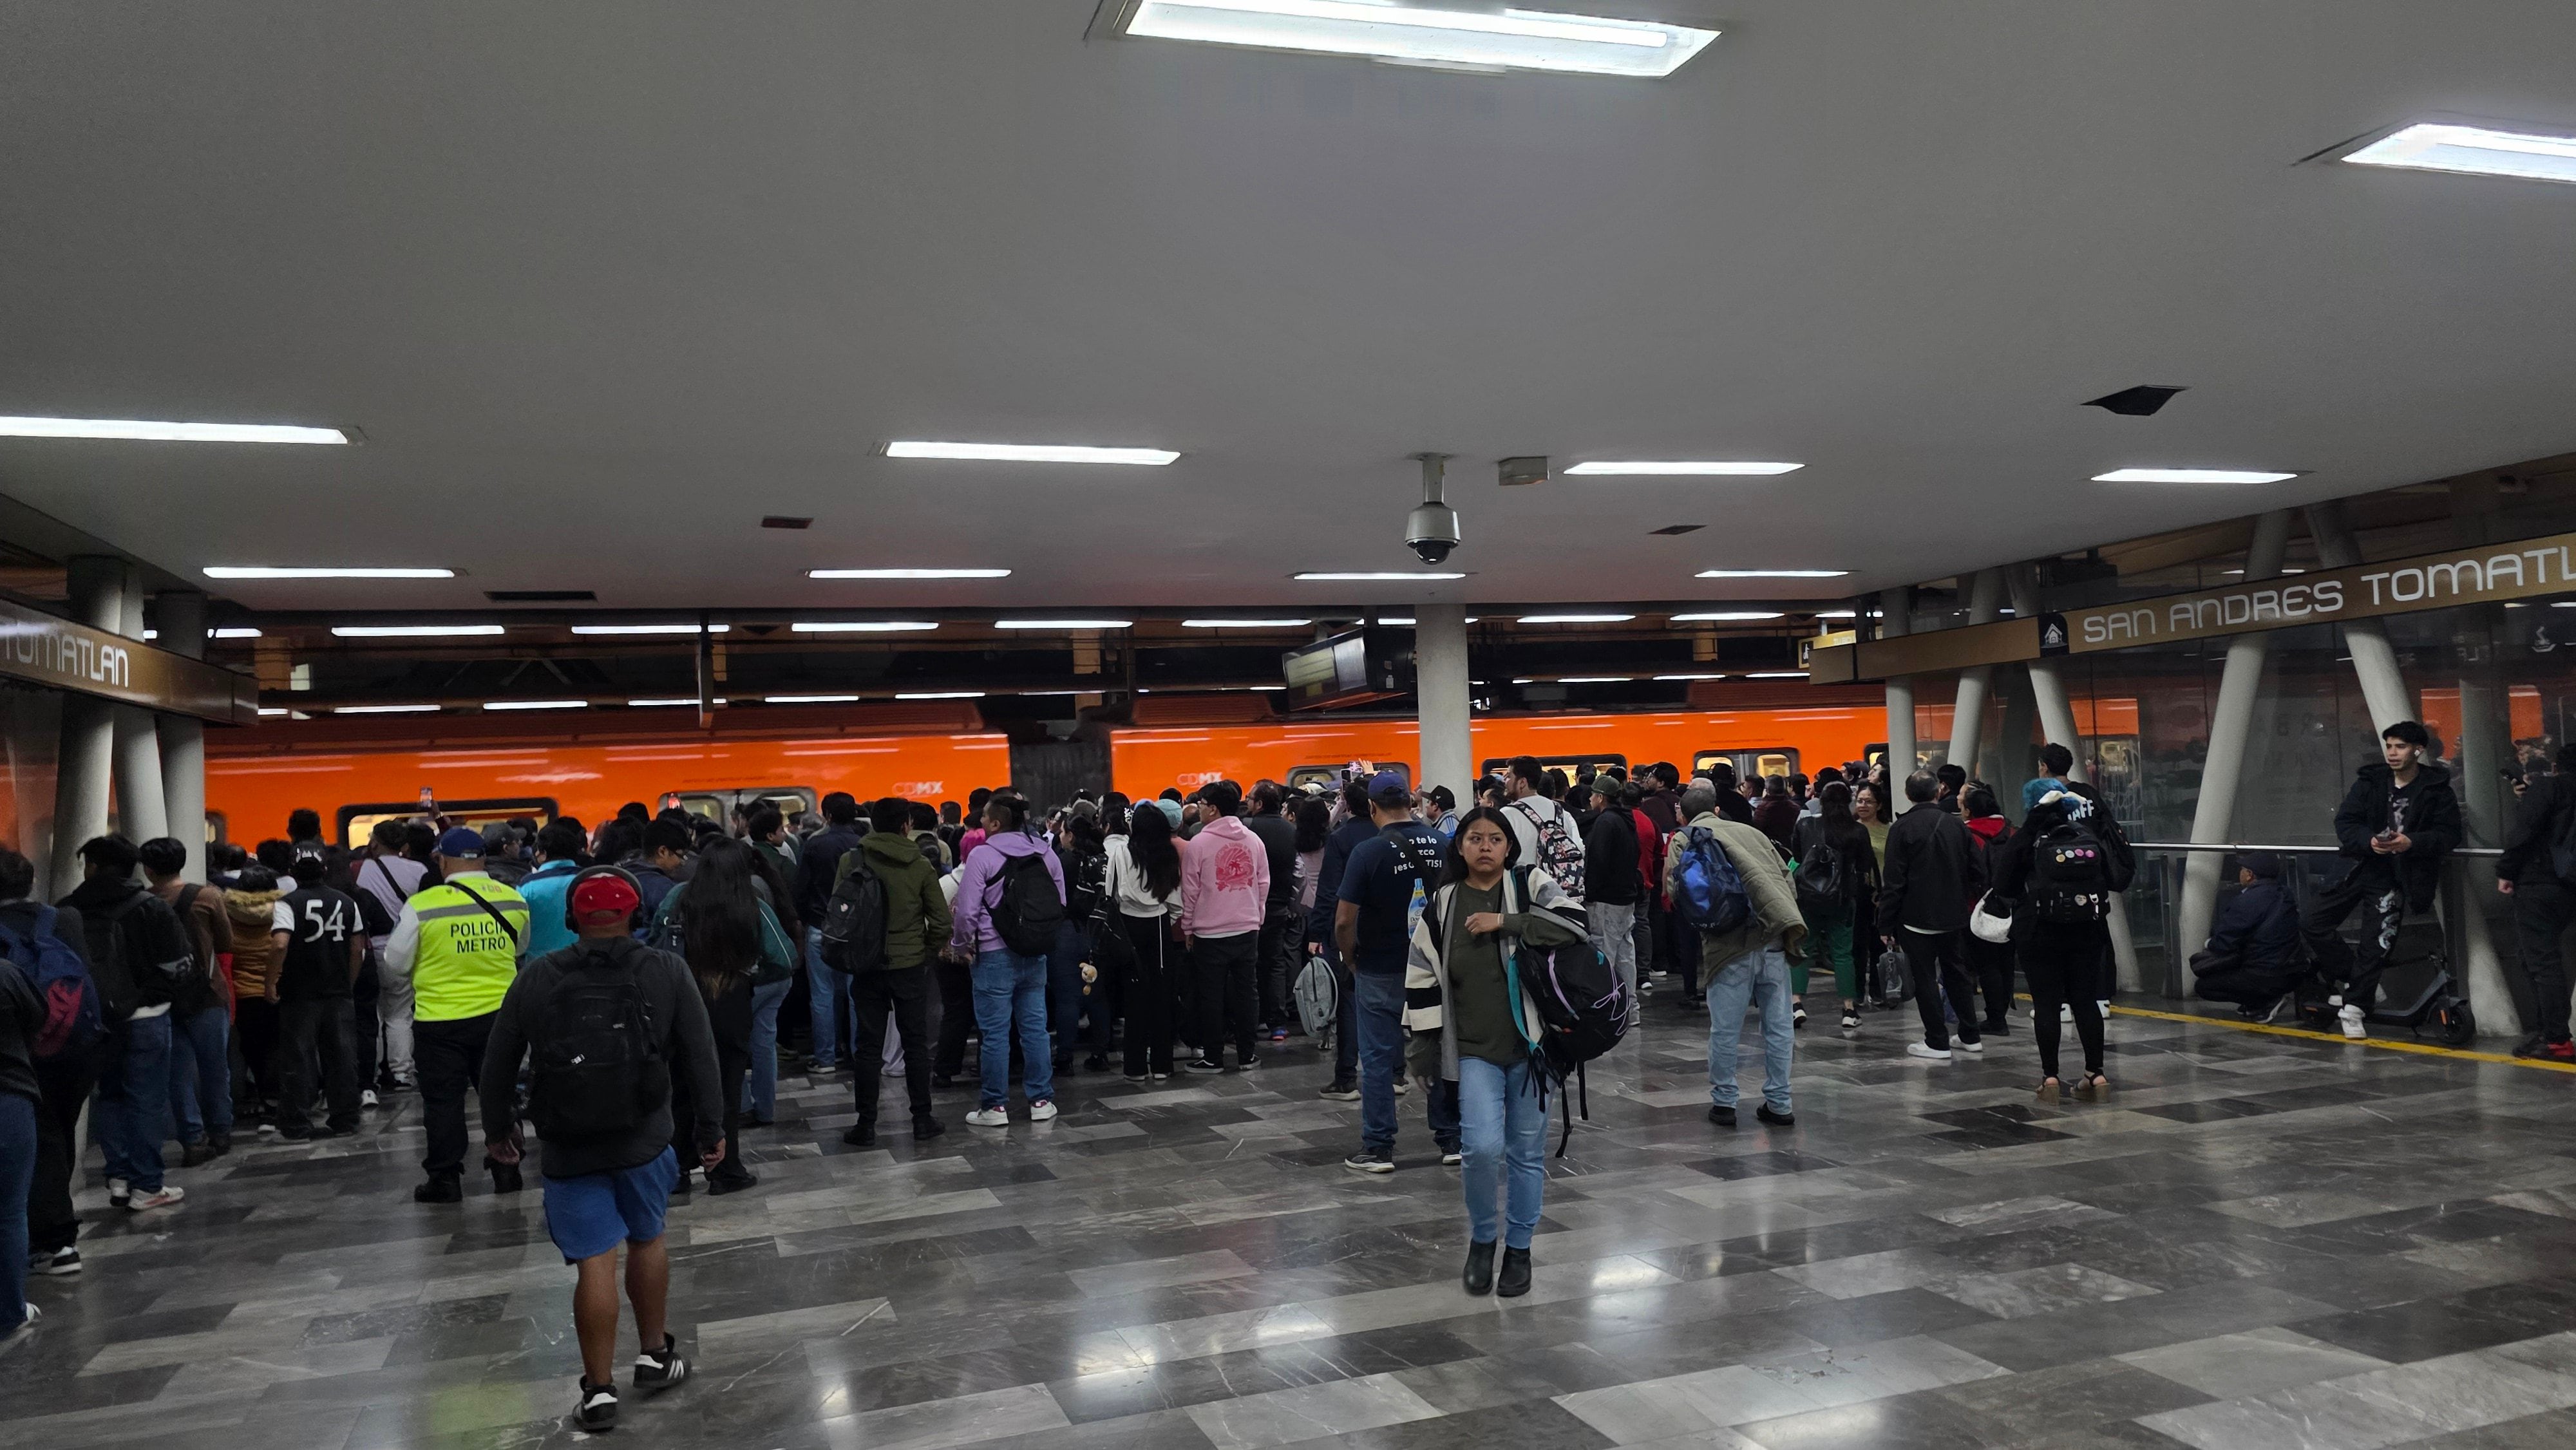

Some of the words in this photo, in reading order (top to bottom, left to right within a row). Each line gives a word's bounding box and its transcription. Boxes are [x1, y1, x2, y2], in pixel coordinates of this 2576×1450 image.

[2083, 608, 2156, 643] SAN
[2169, 579, 2344, 632] ANDRES
[2360, 546, 2576, 605] TOMATL
[1177, 771, 1223, 786] CDMX
[892, 780, 945, 796] CDMX
[1427, 835, 1437, 844] lo
[303, 899, 346, 943] 54
[457, 936, 506, 954] METRO
